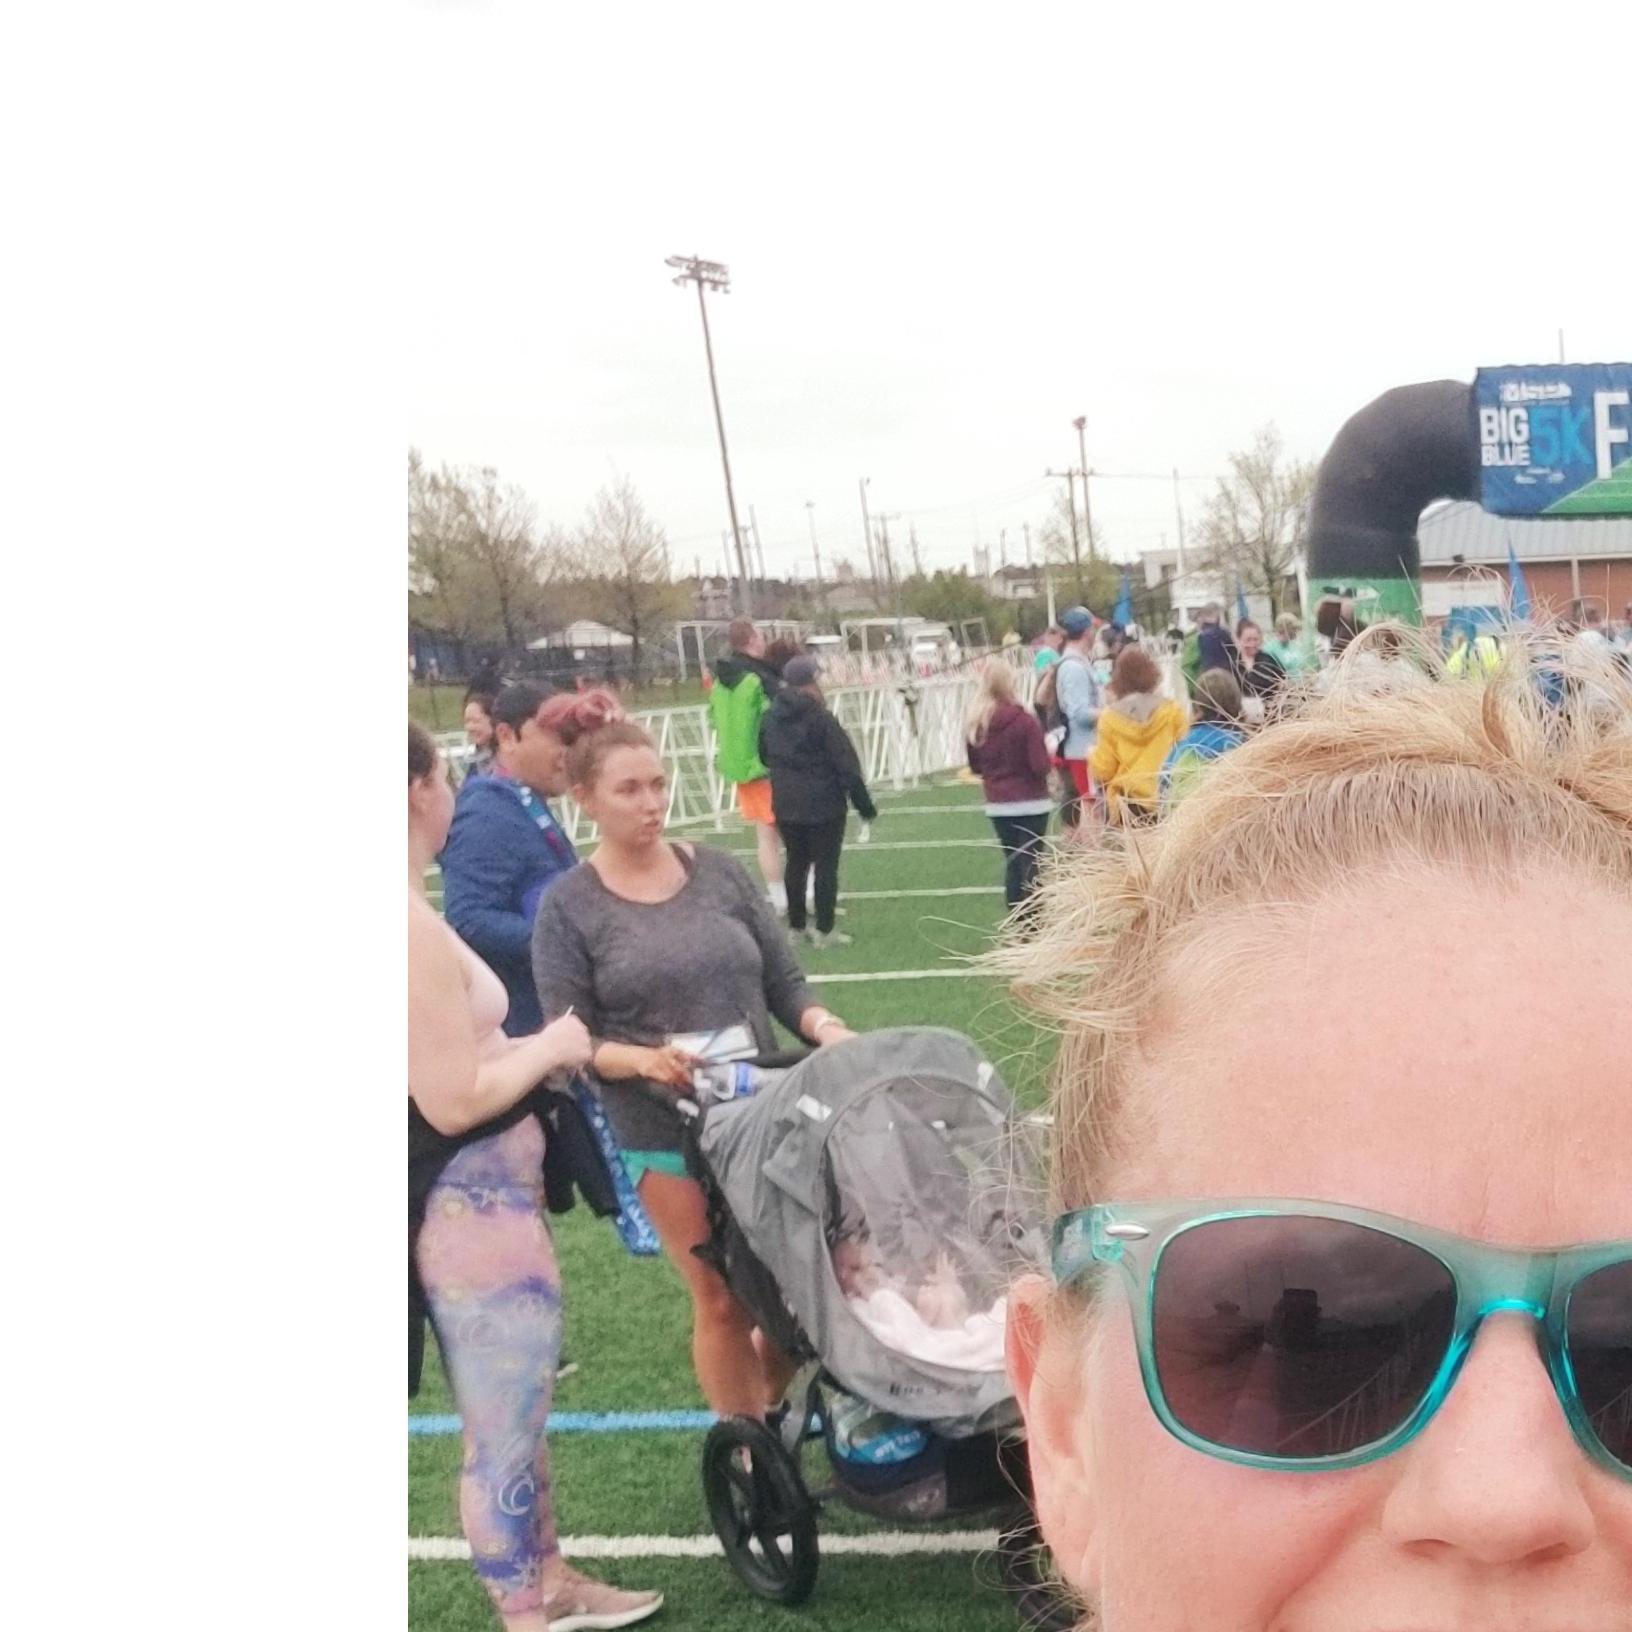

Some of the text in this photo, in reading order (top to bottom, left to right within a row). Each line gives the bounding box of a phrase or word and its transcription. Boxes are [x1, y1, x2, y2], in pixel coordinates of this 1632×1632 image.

[1480, 407, 1529, 444] BIG
[1529, 406, 1595, 465] 5K
[1482, 444, 1531, 466] BLUE
